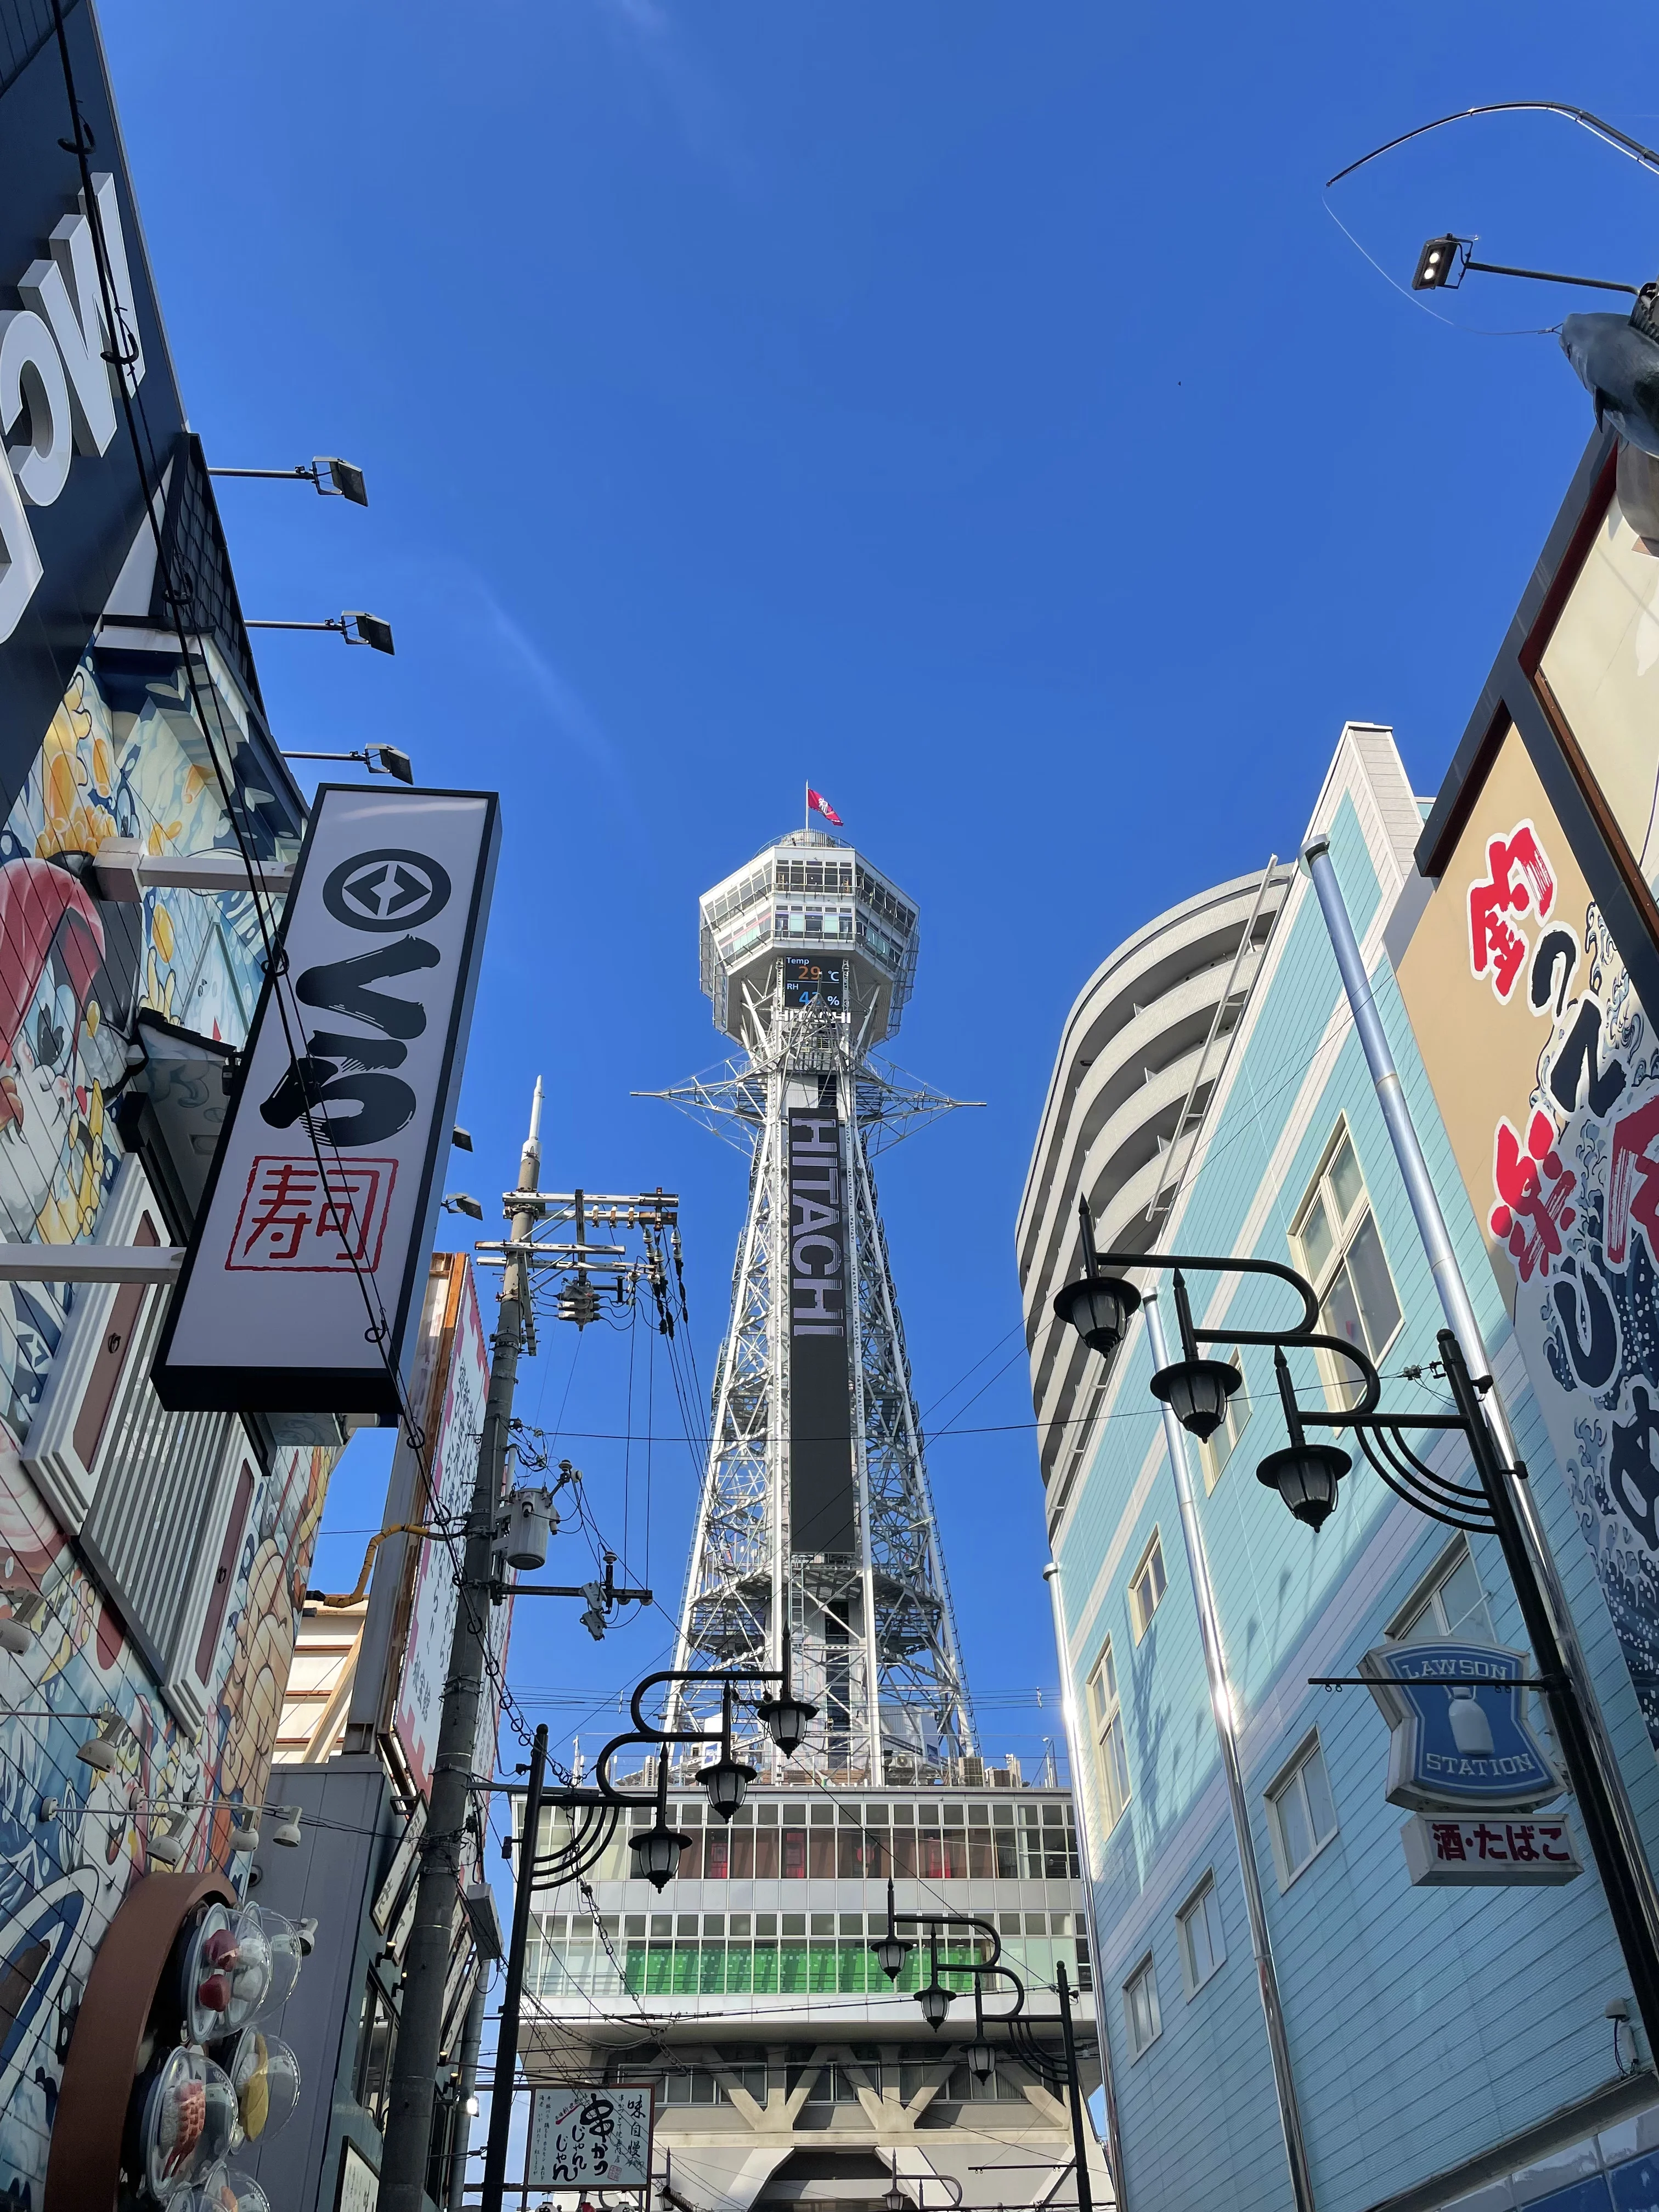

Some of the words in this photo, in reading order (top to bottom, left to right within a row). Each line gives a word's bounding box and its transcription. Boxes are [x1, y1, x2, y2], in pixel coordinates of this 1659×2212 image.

[798, 966, 821, 980] 29
[827, 996, 840, 1006] %
[259, 934, 441, 1147] くら
[792, 1118, 844, 1337] HITACHI
[1402, 1659, 1507, 1679] LAWSON
[1426, 1753, 1535, 1775] STATION
[580, 2093, 615, 2176] 串かつ
